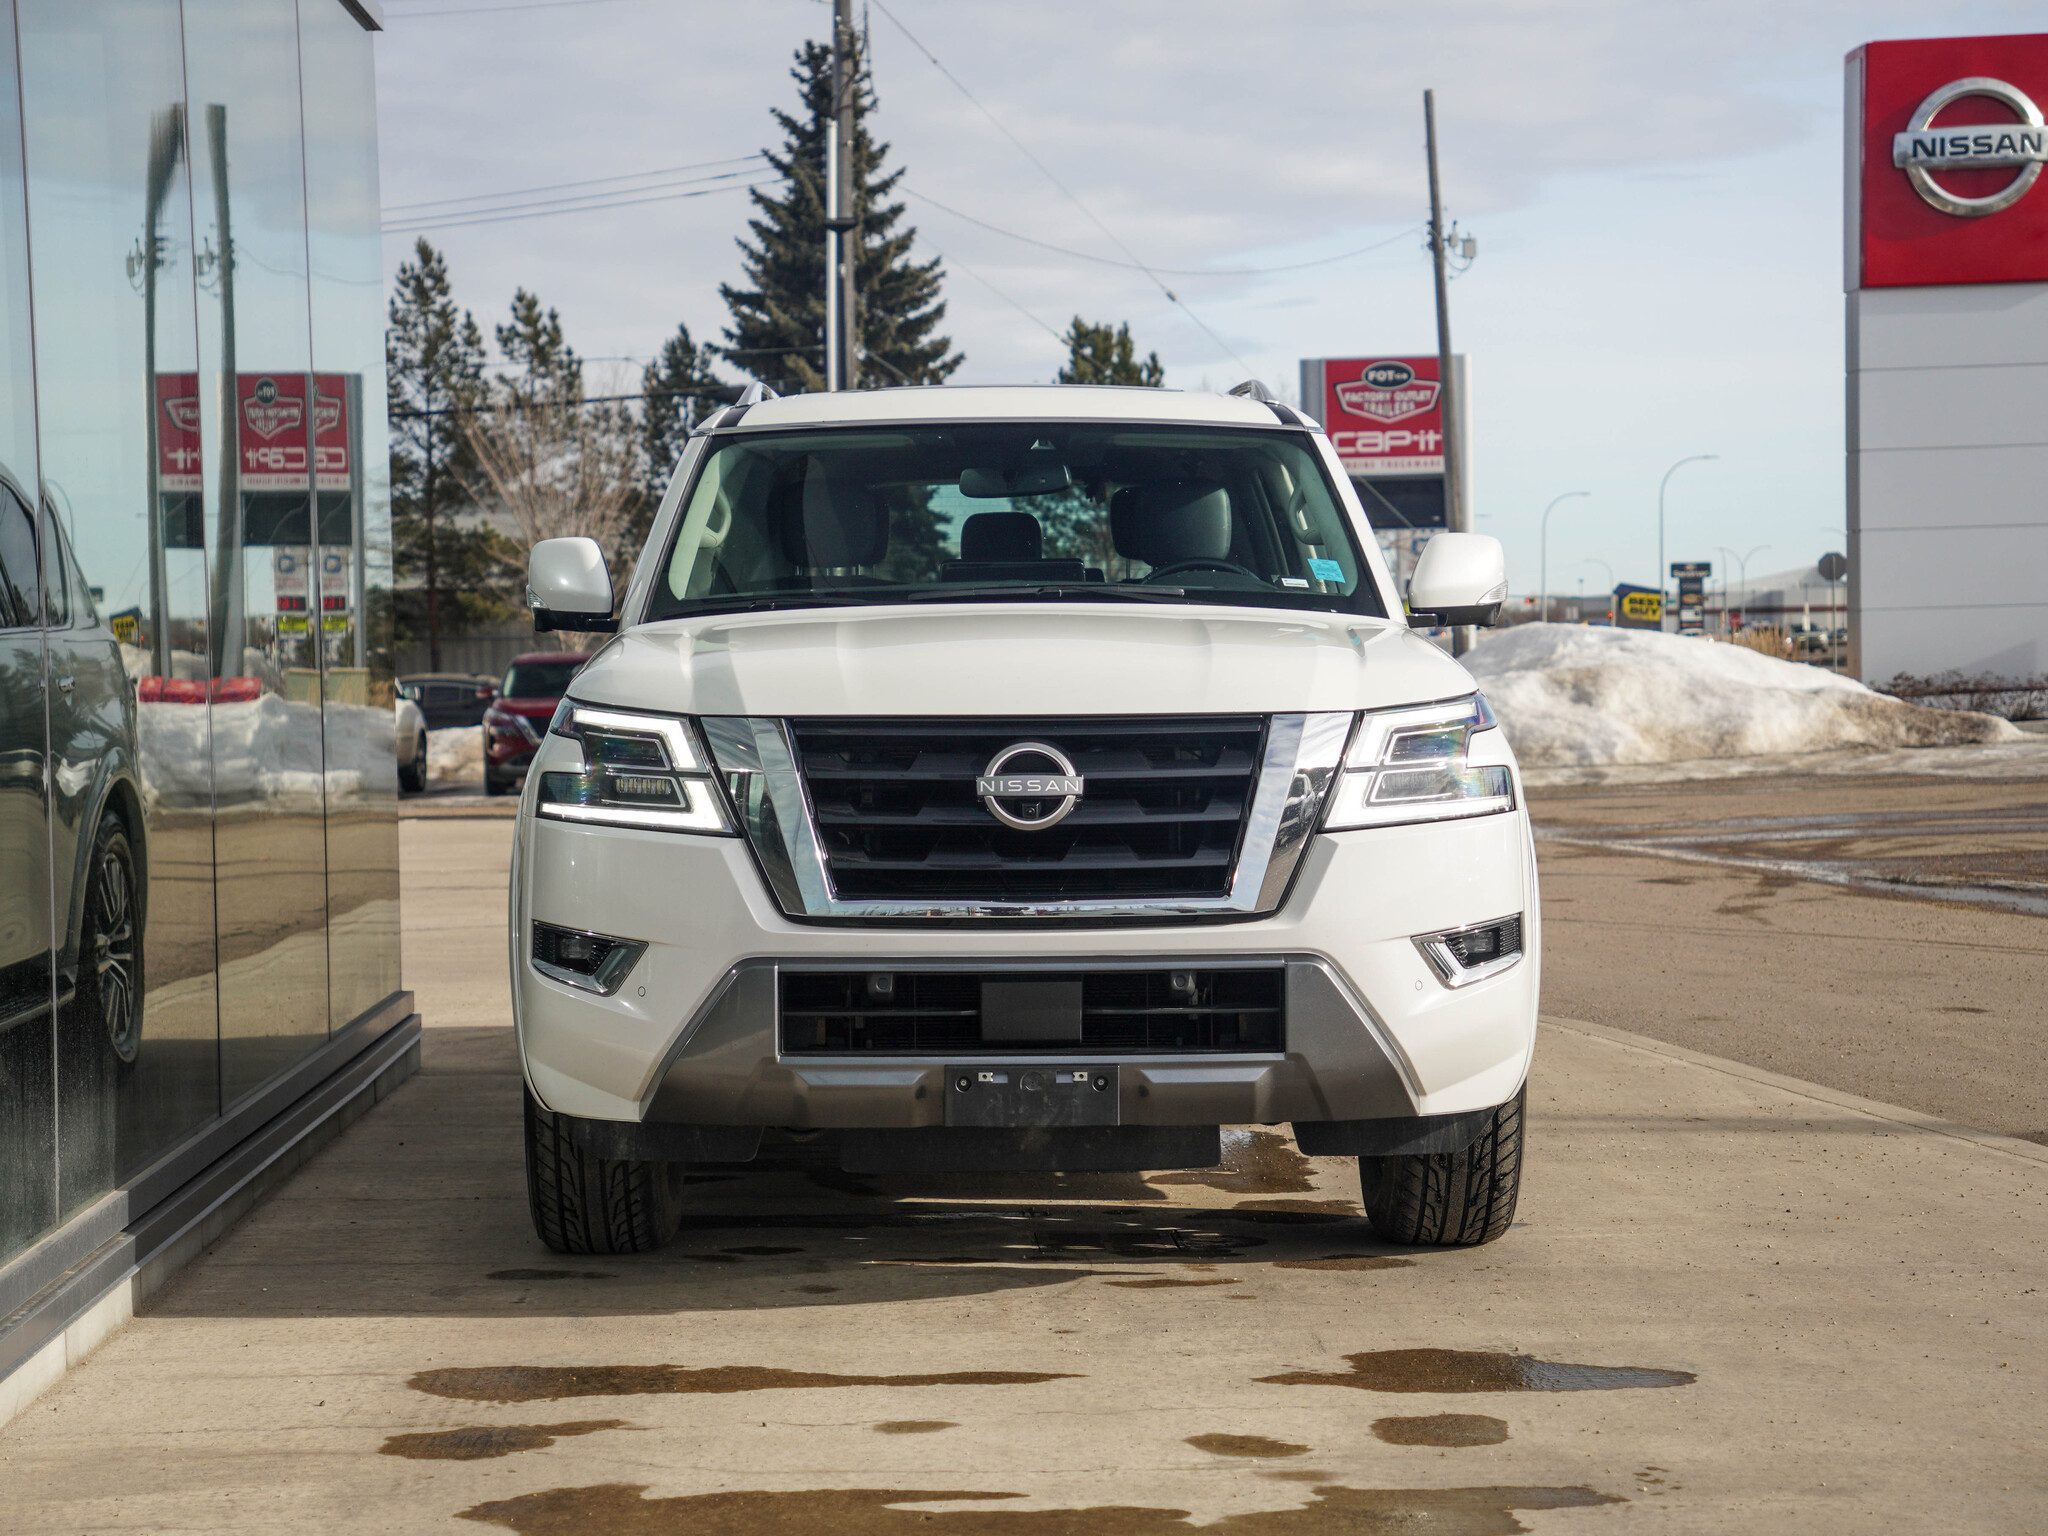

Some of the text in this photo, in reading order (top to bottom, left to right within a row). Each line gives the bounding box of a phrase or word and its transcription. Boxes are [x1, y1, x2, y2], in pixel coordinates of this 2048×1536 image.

[1912, 133, 2041, 158] NISSAN
[1344, 389, 1432, 402] FACTORY OUTLET
[1629, 597, 1661, 606] BEST
[1630, 606, 1660, 616] BUY
[980, 780, 1079, 792] NISSAN
